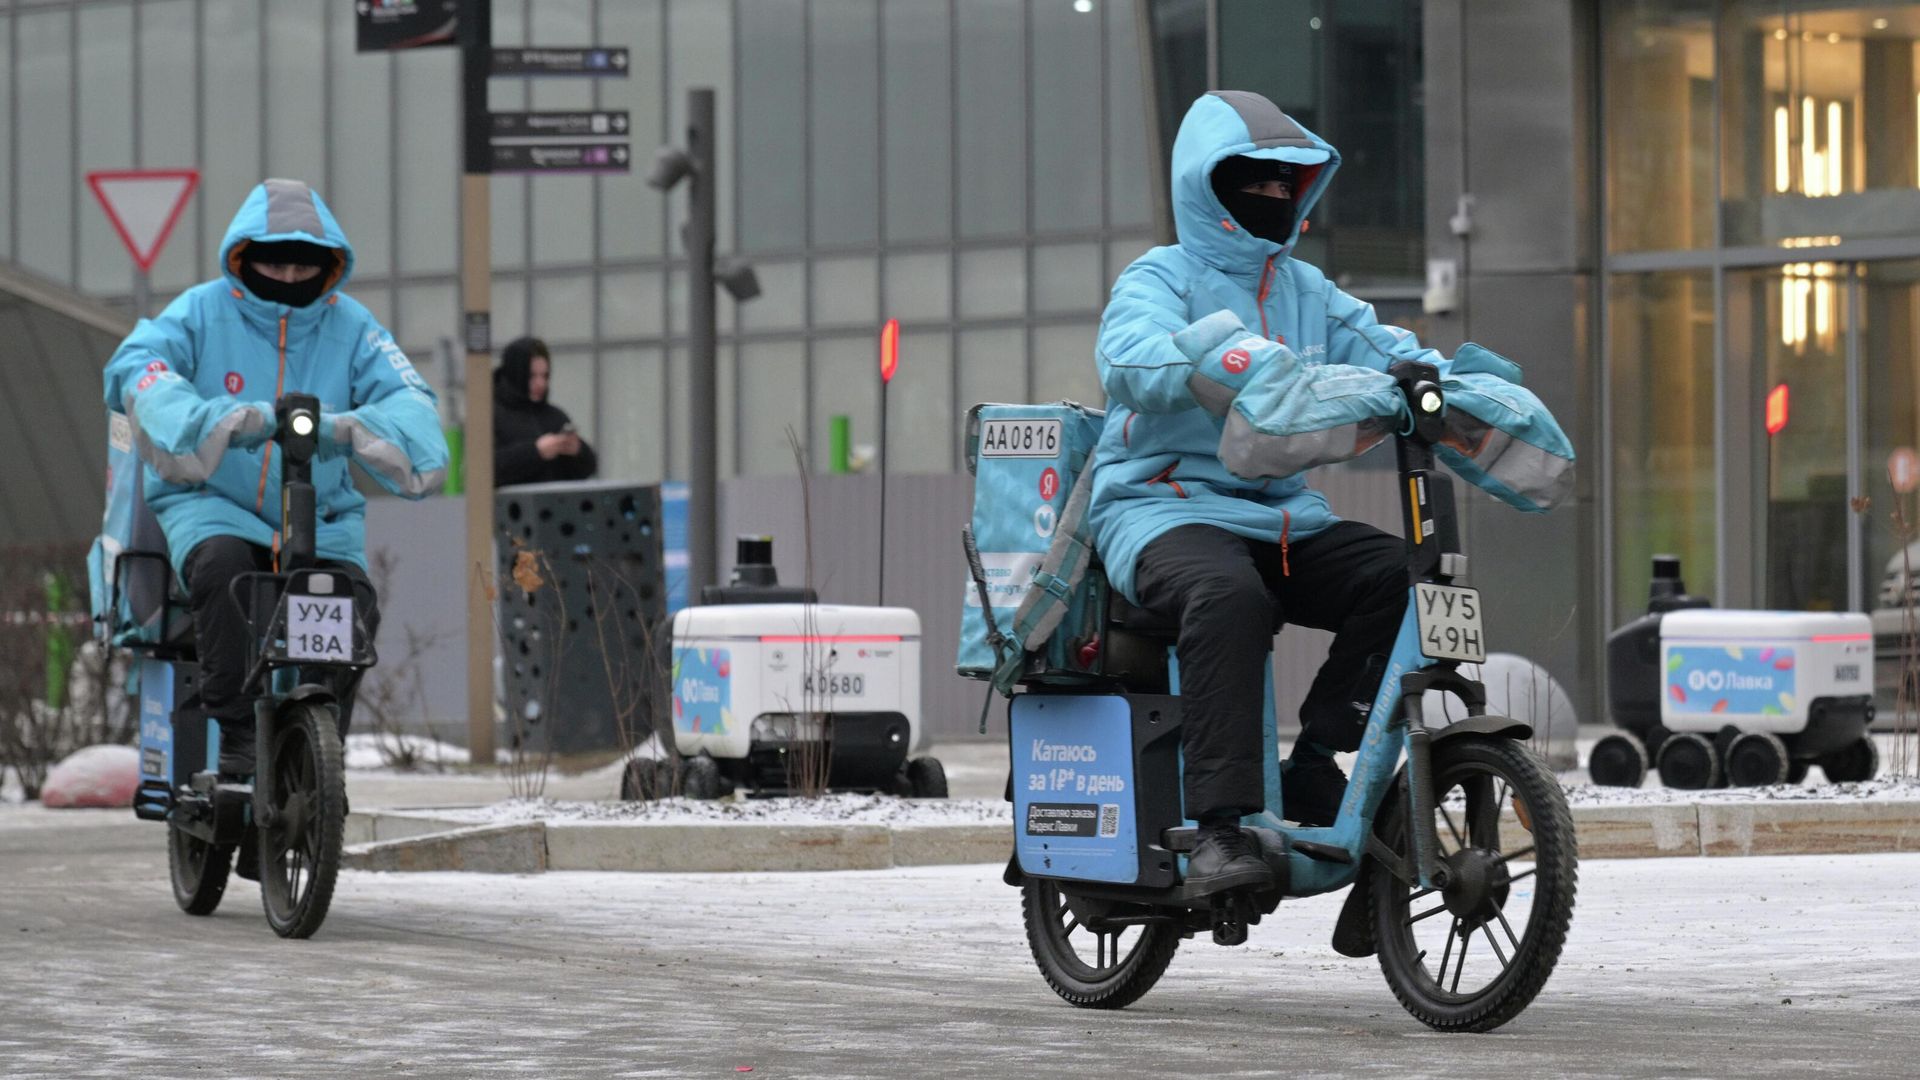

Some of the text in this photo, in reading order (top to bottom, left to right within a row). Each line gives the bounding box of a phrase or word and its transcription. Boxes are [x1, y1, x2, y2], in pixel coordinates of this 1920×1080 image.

[1043, 473, 1054, 495] Я
[298, 633, 344, 654] 18А
[1031, 738, 1097, 762] Катаюсь
[1028, 773, 1046, 791] за
[1076, 774, 1086, 792] в
[1086, 774, 1125, 796] день
